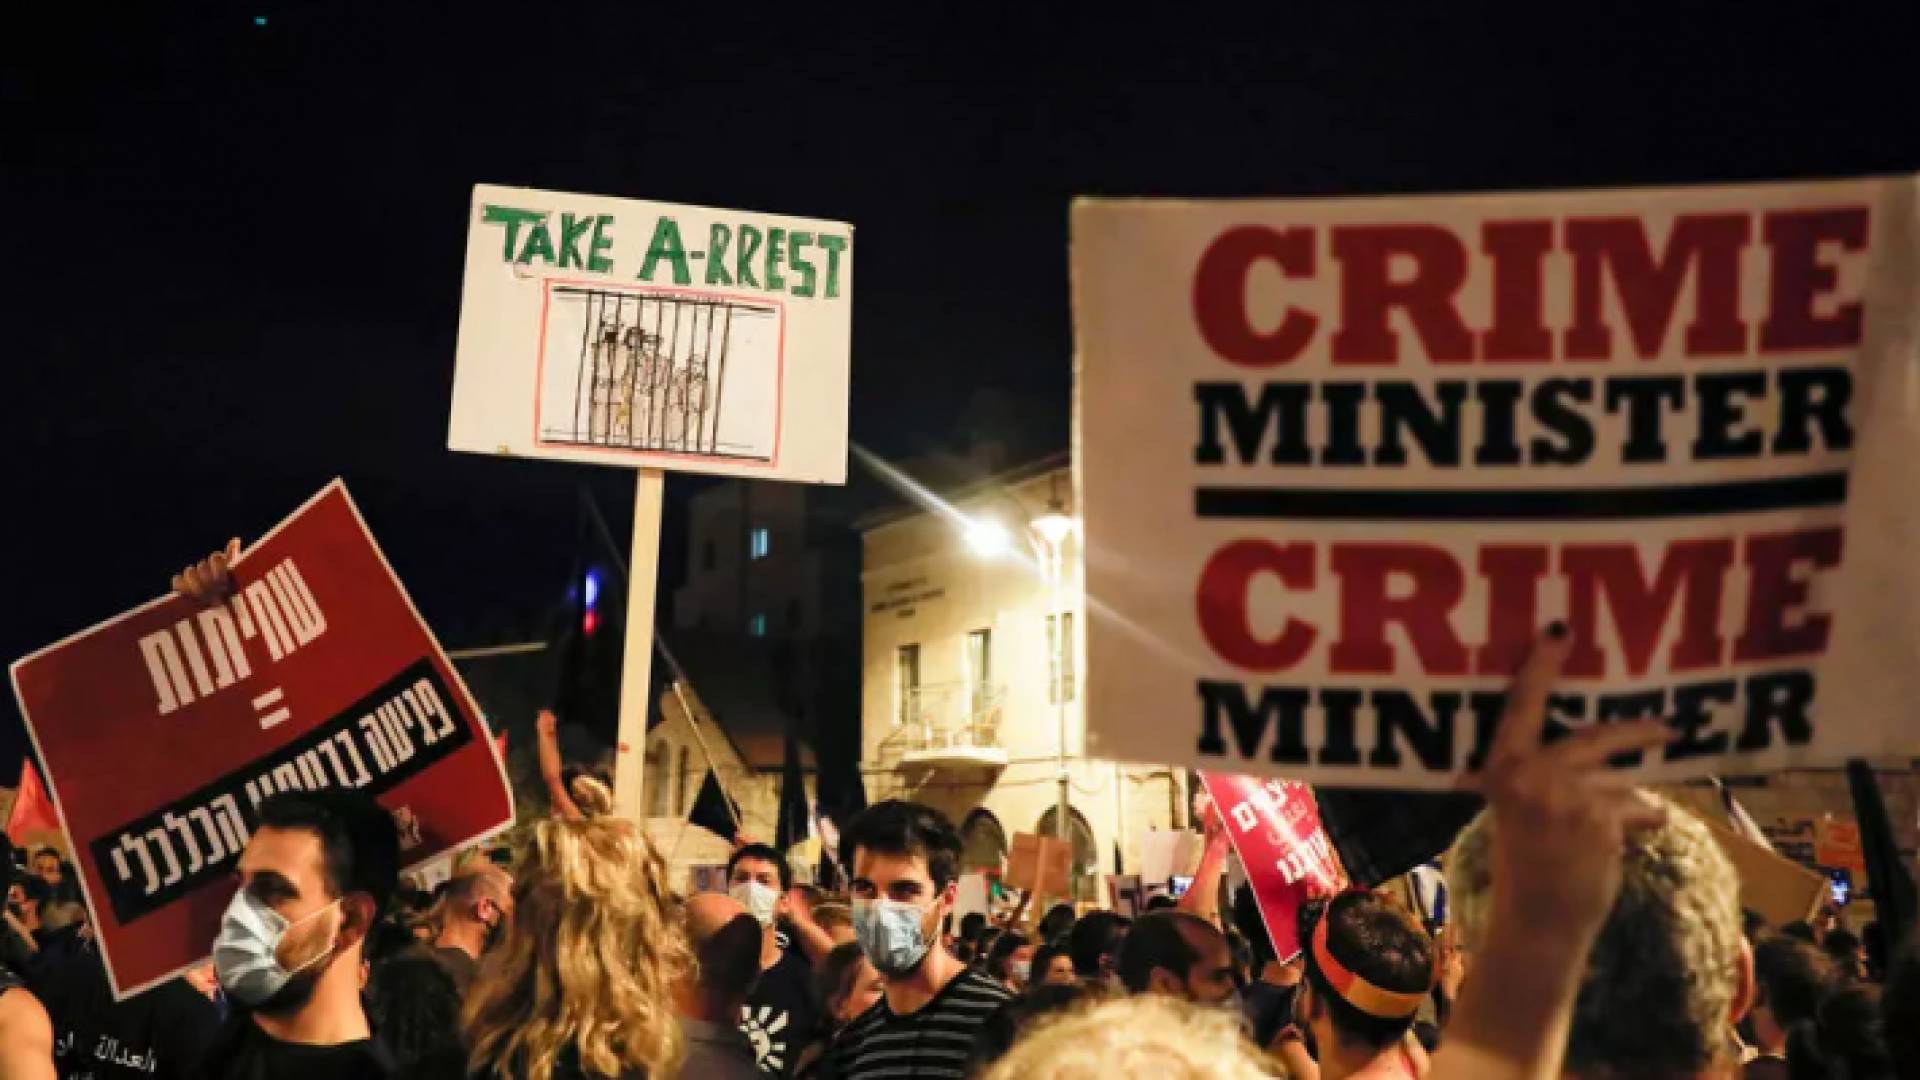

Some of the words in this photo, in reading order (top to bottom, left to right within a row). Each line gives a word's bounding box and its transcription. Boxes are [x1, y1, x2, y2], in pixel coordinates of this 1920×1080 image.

[481, 204, 614, 273] TAKE
[636, 215, 848, 298] A-RREST
[1191, 207, 1869, 367] CRIME
[1194, 366, 1856, 467] MINISTER
[138, 556, 328, 716] שחיתות
[1196, 528, 1845, 676] CRIME
[358, 677, 458, 775] פגיעה
[110, 793, 250, 895] הכלכלי
